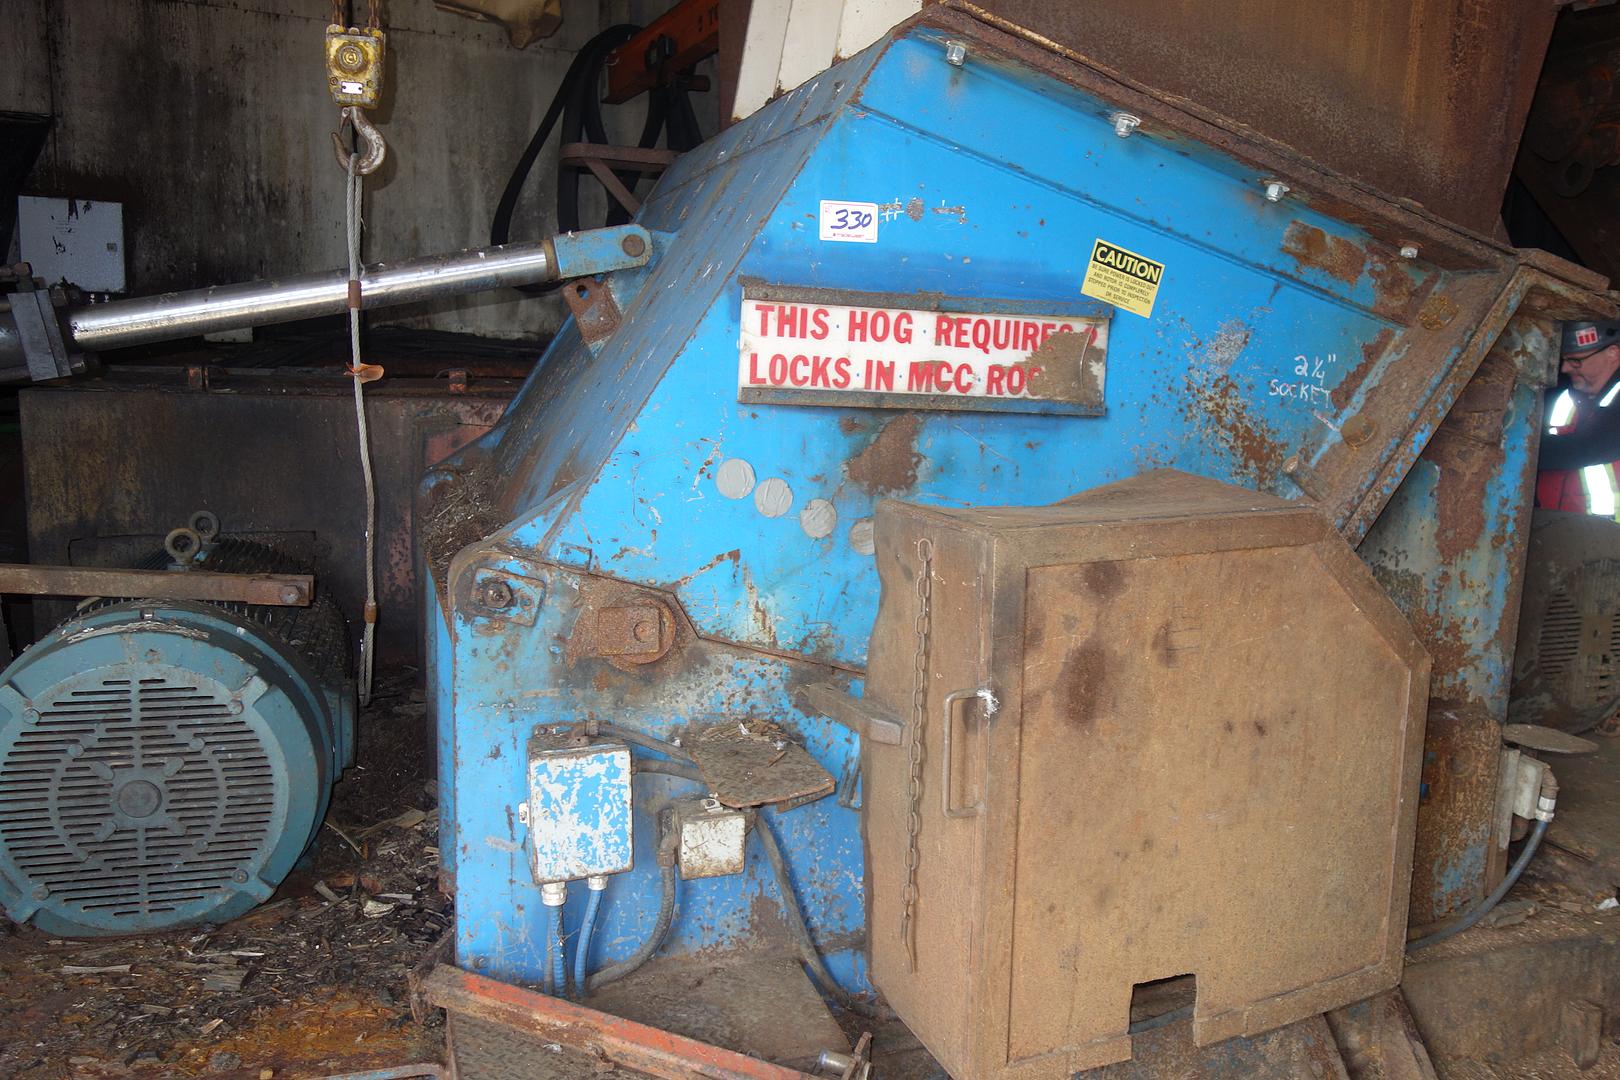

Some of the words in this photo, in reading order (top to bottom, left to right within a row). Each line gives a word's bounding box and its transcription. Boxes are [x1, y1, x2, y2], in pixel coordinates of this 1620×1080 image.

[830, 208, 873, 230] 330
[1096, 246, 1160, 281] CAUTION
[1088, 277, 1107, 288] STOPPED
[755, 304, 830, 340] THIS
[848, 310, 913, 344] HOG
[749, 353, 852, 389] LOCKS
[864, 359, 895, 391] IN
[907, 360, 973, 394] MCC
[1268, 378, 1331, 409] SOCKET
